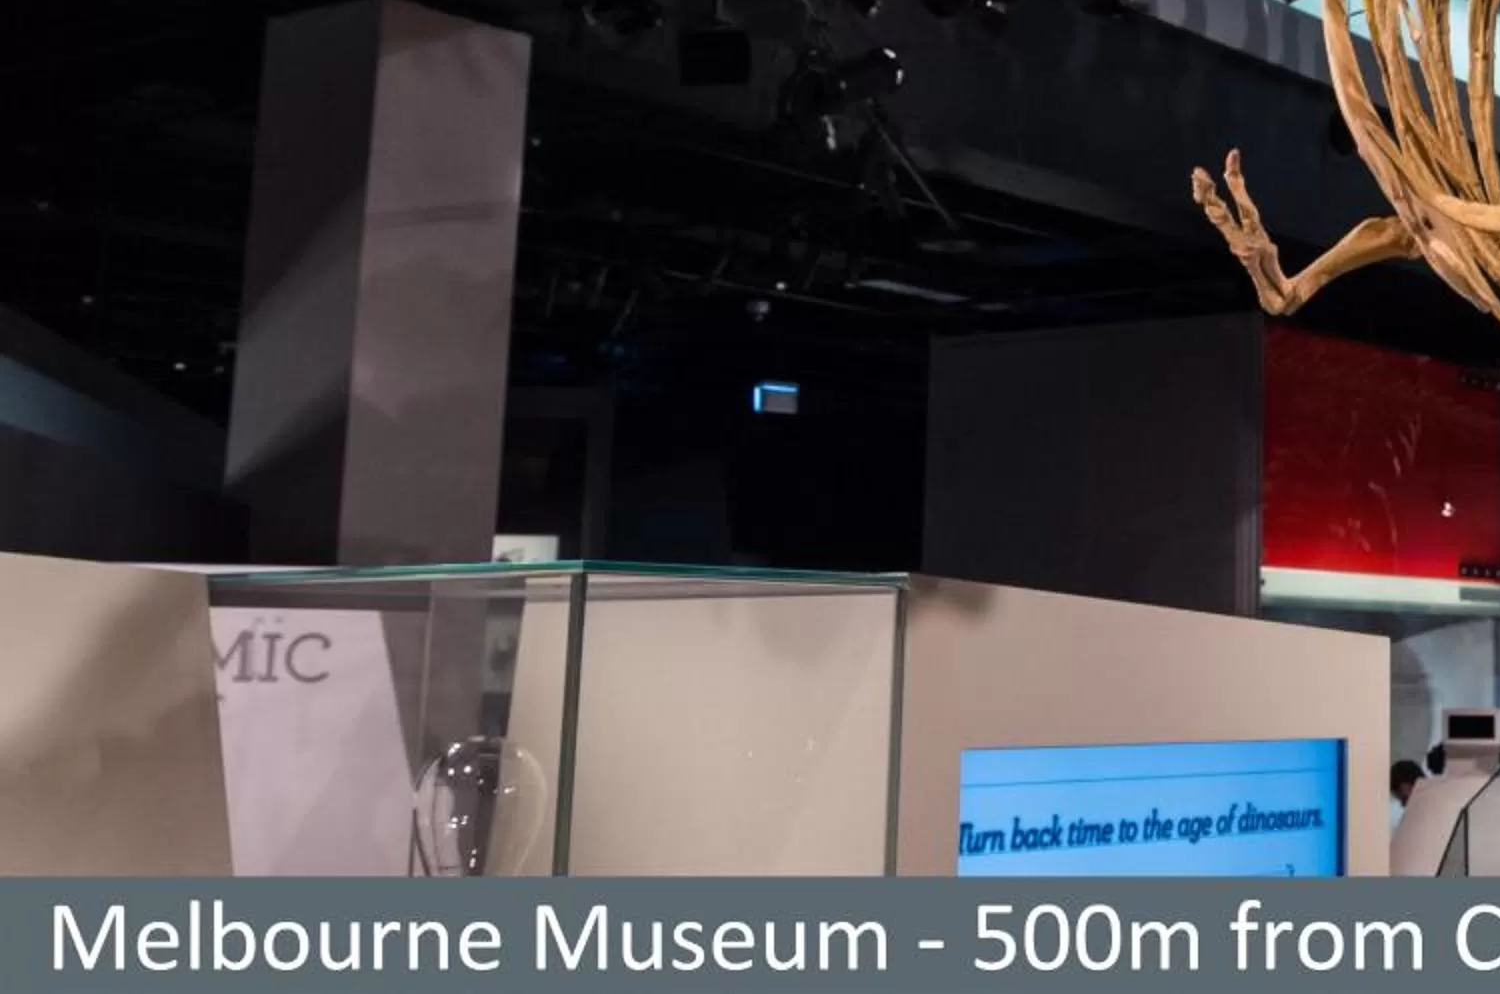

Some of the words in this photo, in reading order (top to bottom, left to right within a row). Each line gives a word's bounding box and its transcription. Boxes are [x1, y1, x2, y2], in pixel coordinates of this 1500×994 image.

[959, 822, 1005, 855] Turn
[1011, 814, 1063, 852] back
[1068, 818, 1115, 847] time
[1119, 818, 1139, 843] to
[1143, 807, 1173, 842] the
[1177, 814, 1213, 844] age
[1216, 802, 1239, 836] of
[1238, 801, 1325, 834] dinosaurs.
